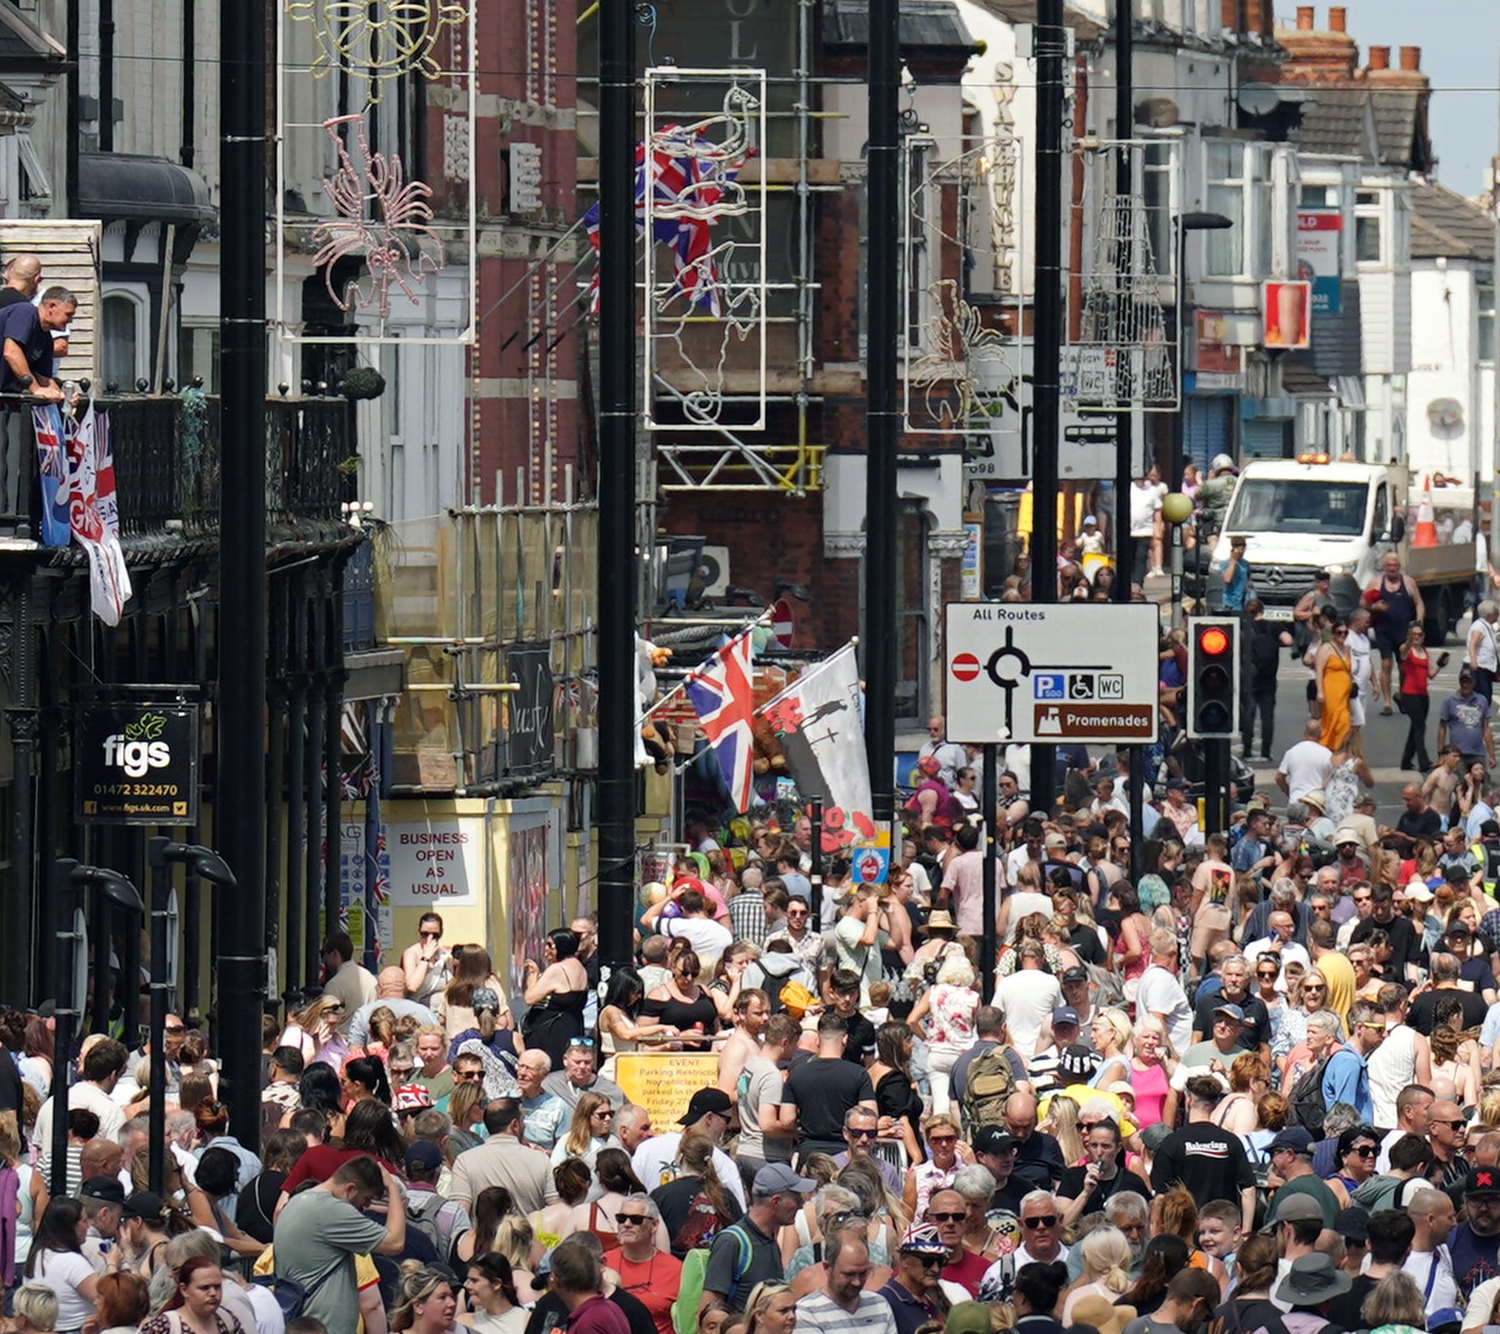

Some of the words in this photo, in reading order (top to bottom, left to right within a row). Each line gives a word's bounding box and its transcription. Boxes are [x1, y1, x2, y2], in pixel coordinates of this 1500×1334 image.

[973, 609, 992, 620] All
[998, 609, 1045, 621] Routes
[1102, 681, 1121, 694] WC
[1067, 714, 1149, 727] Promenades
[103, 734, 171, 778] figs
[94, 784, 131, 796] 01472
[133, 784, 178, 796] 322470
[400, 833, 469, 845] BUSINESS
[415, 850, 454, 861] OPEN
[426, 867, 445, 878] AS
[411, 883, 458, 895] USUAL
[669, 1058, 700, 1066] EVENT
[639, 1068, 673, 1077] Parking
